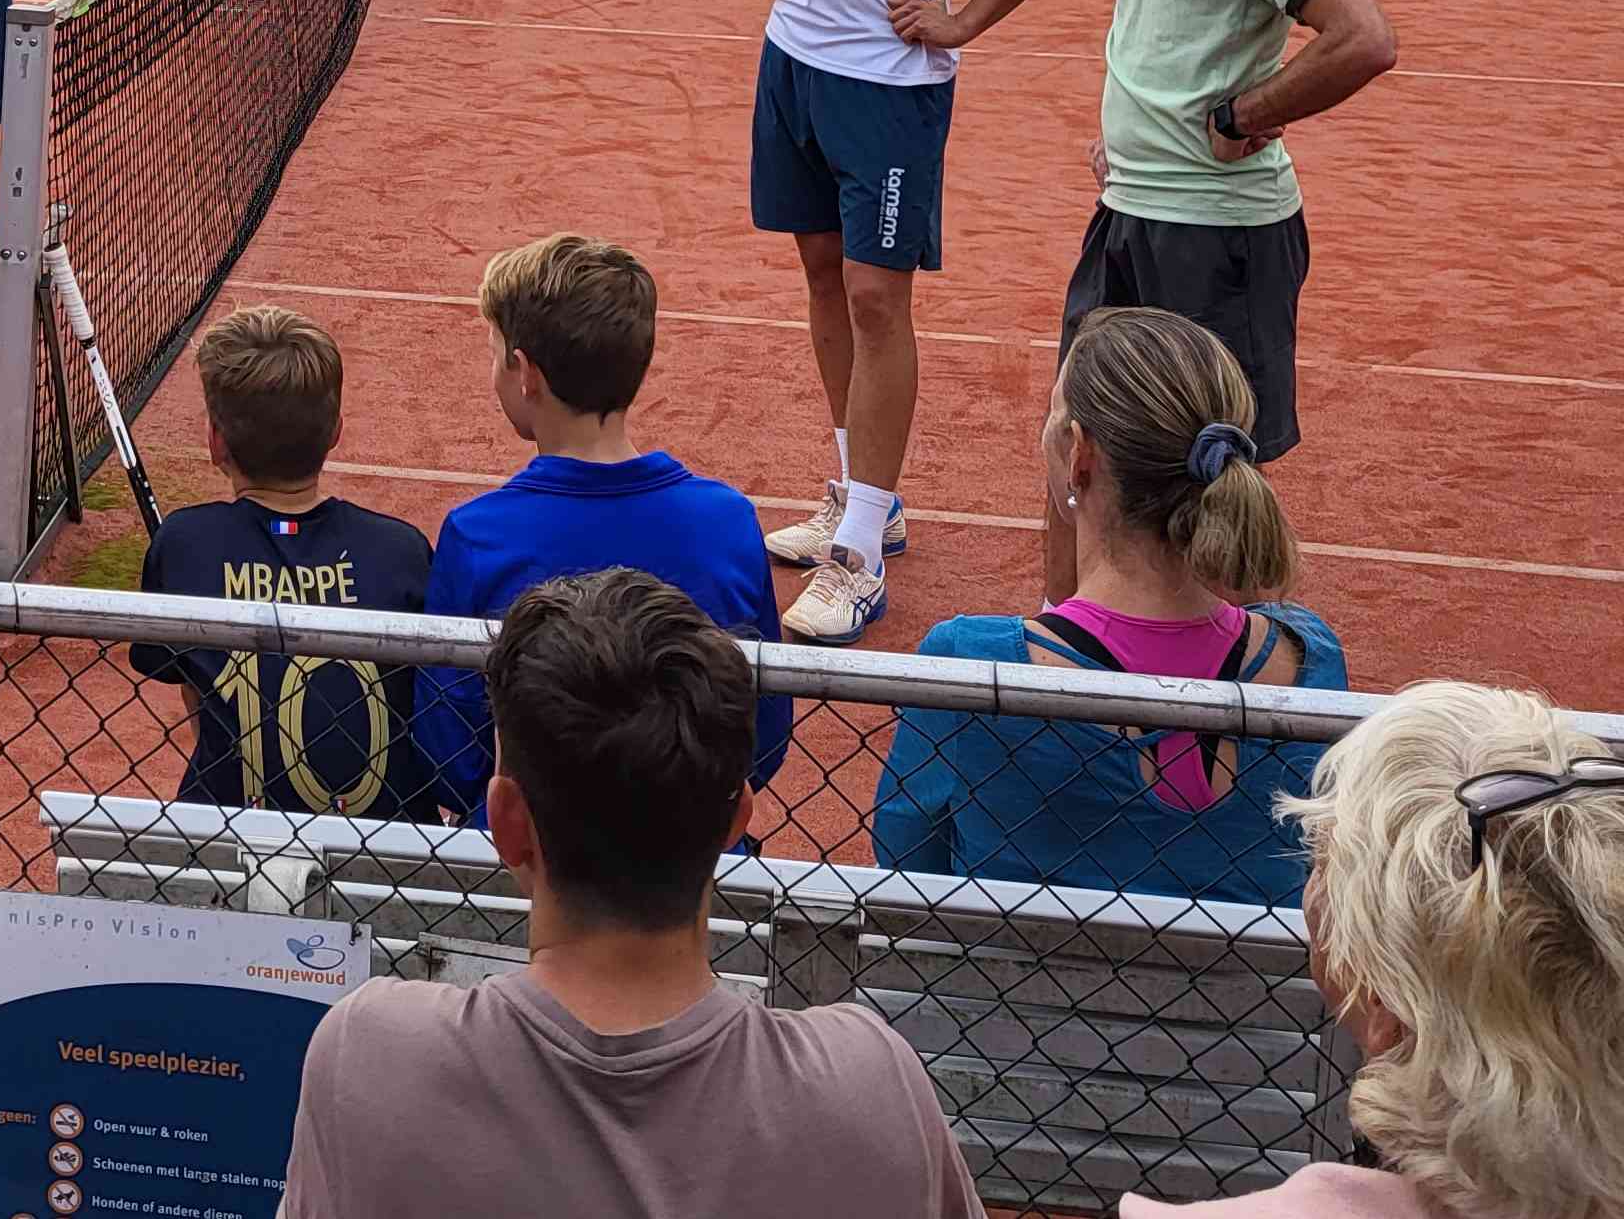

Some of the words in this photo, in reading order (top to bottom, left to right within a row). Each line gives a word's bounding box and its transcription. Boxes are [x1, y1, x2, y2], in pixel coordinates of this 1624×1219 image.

[881, 167, 905, 249] tamsma
[223, 549, 358, 605] MBAPPÉ
[212, 650, 390, 817] 10
[111, 917, 197, 941] Vision
[246, 962, 346, 986] oranjewoud
[58, 1040, 103, 1064] Veel
[108, 1050, 246, 1081] speelplezier,
[93, 1118, 126, 1135] Open
[129, 1125, 157, 1137] vuur
[159, 1126, 171, 1138] &
[174, 1127, 209, 1143] roken
[92, 1157, 153, 1175] Schoenen
[156, 1165, 180, 1178] met
[183, 1166, 218, 1183] lange
[221, 1171, 260, 1187] stalen
[262, 1178, 287, 1192] nop
[91, 1195, 139, 1212] Honden
[142, 1201, 155, 1213] of
[157, 1203, 201, 1219] andere
[203, 1207, 243, 1219] dieren
